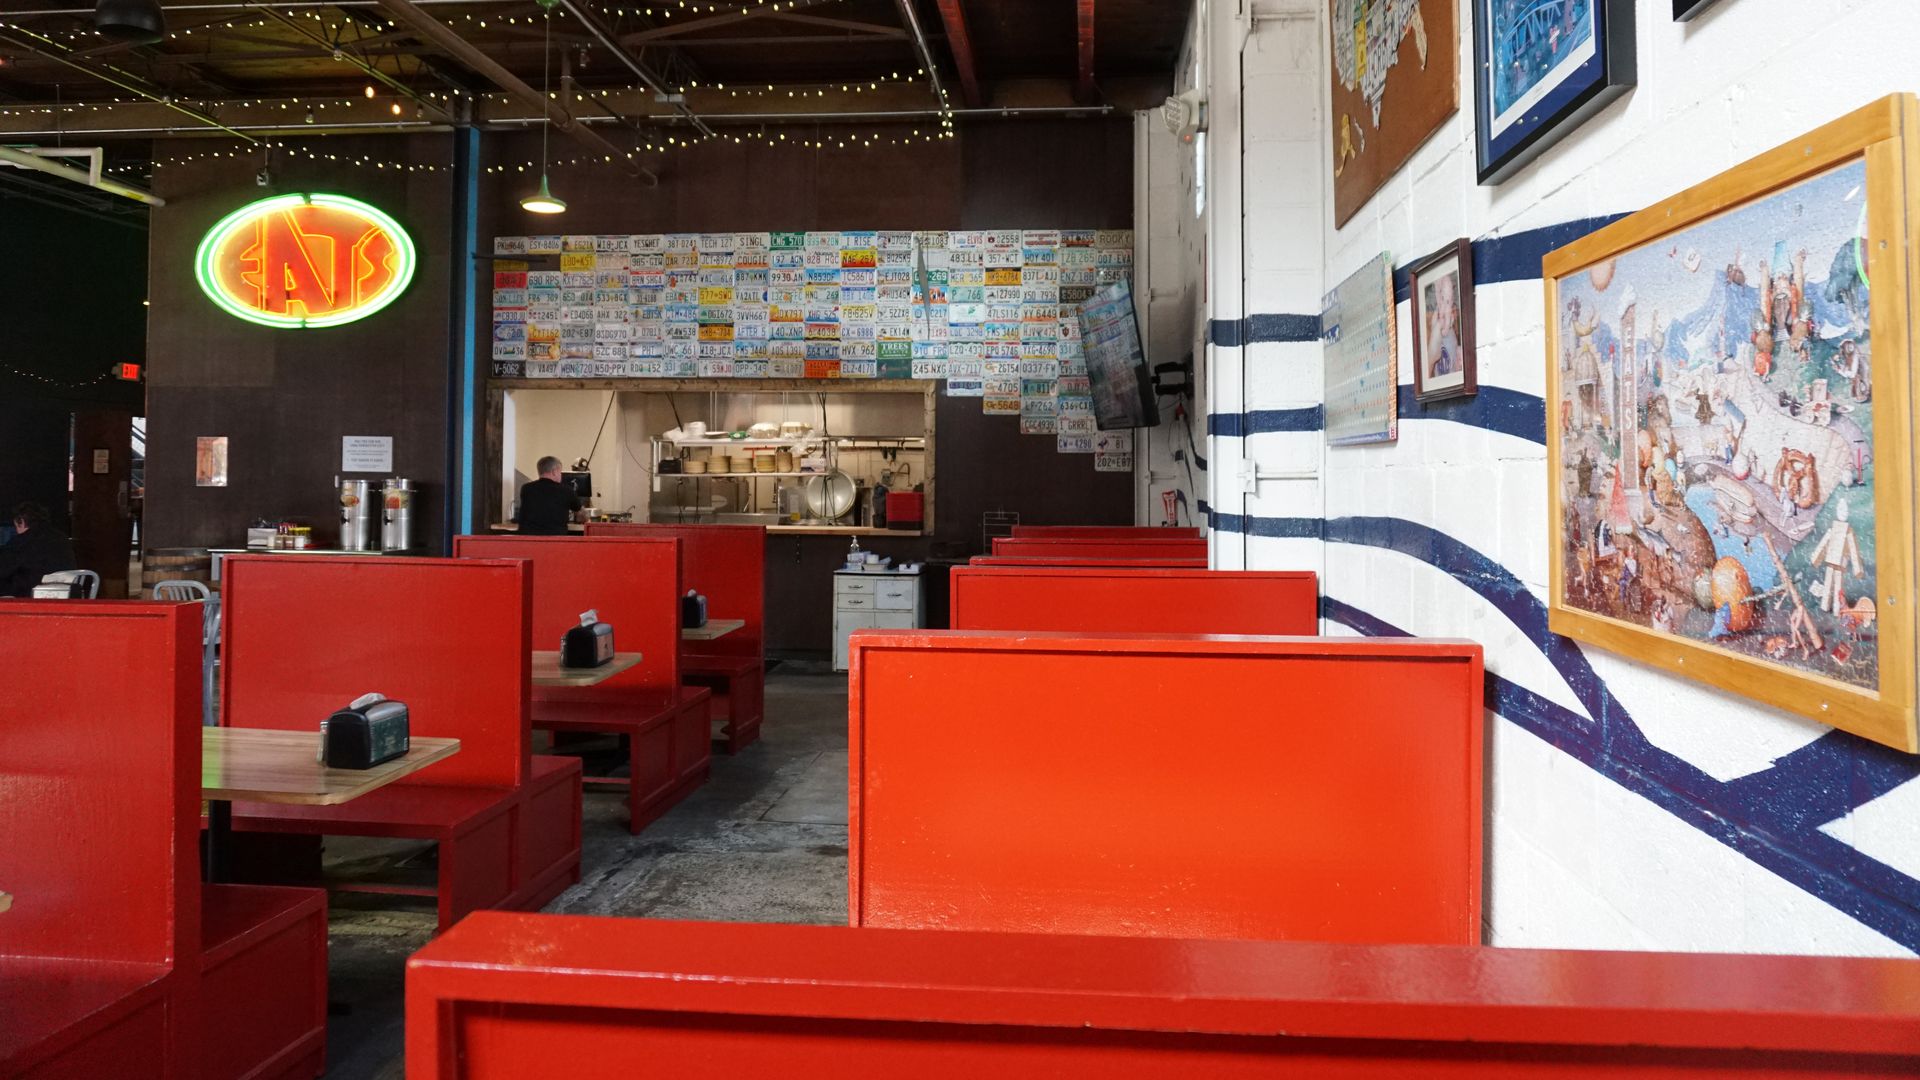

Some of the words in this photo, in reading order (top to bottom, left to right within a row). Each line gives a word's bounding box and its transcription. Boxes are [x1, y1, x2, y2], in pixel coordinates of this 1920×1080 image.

[701, 239, 718, 248] TECH
[854, 237, 872, 246] RISE
[238, 206, 398, 316] EATS
[913, 363, 929, 375] 245
[1624, 325, 1633, 431] EATS
